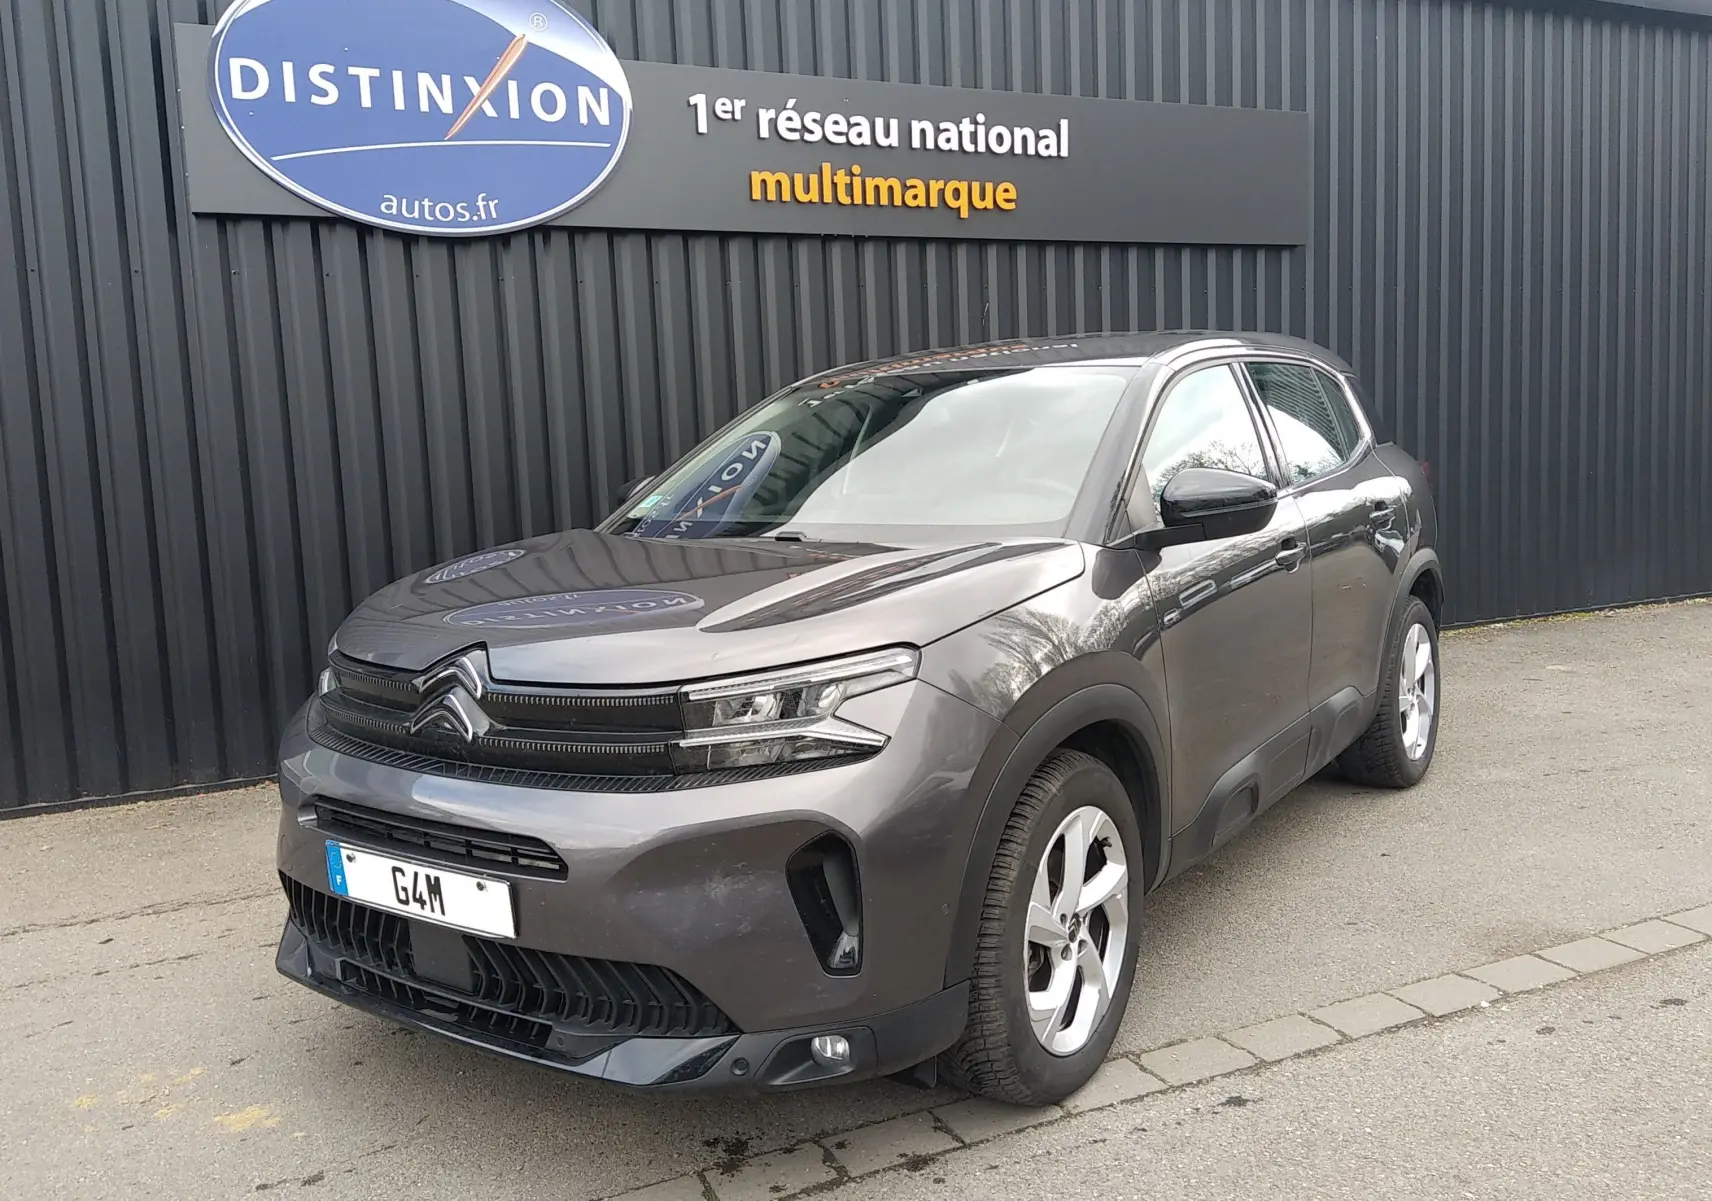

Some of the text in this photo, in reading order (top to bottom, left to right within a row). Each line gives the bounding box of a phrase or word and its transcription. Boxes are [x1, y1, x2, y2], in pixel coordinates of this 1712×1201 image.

[229, 57, 611, 126] DISTINXION
[758, 98, 899, 148] réseau
[911, 113, 1070, 158] national
[380, 193, 499, 222] autos.fr
[750, 162, 1018, 219] multimarque
[391, 865, 446, 917] G4M
